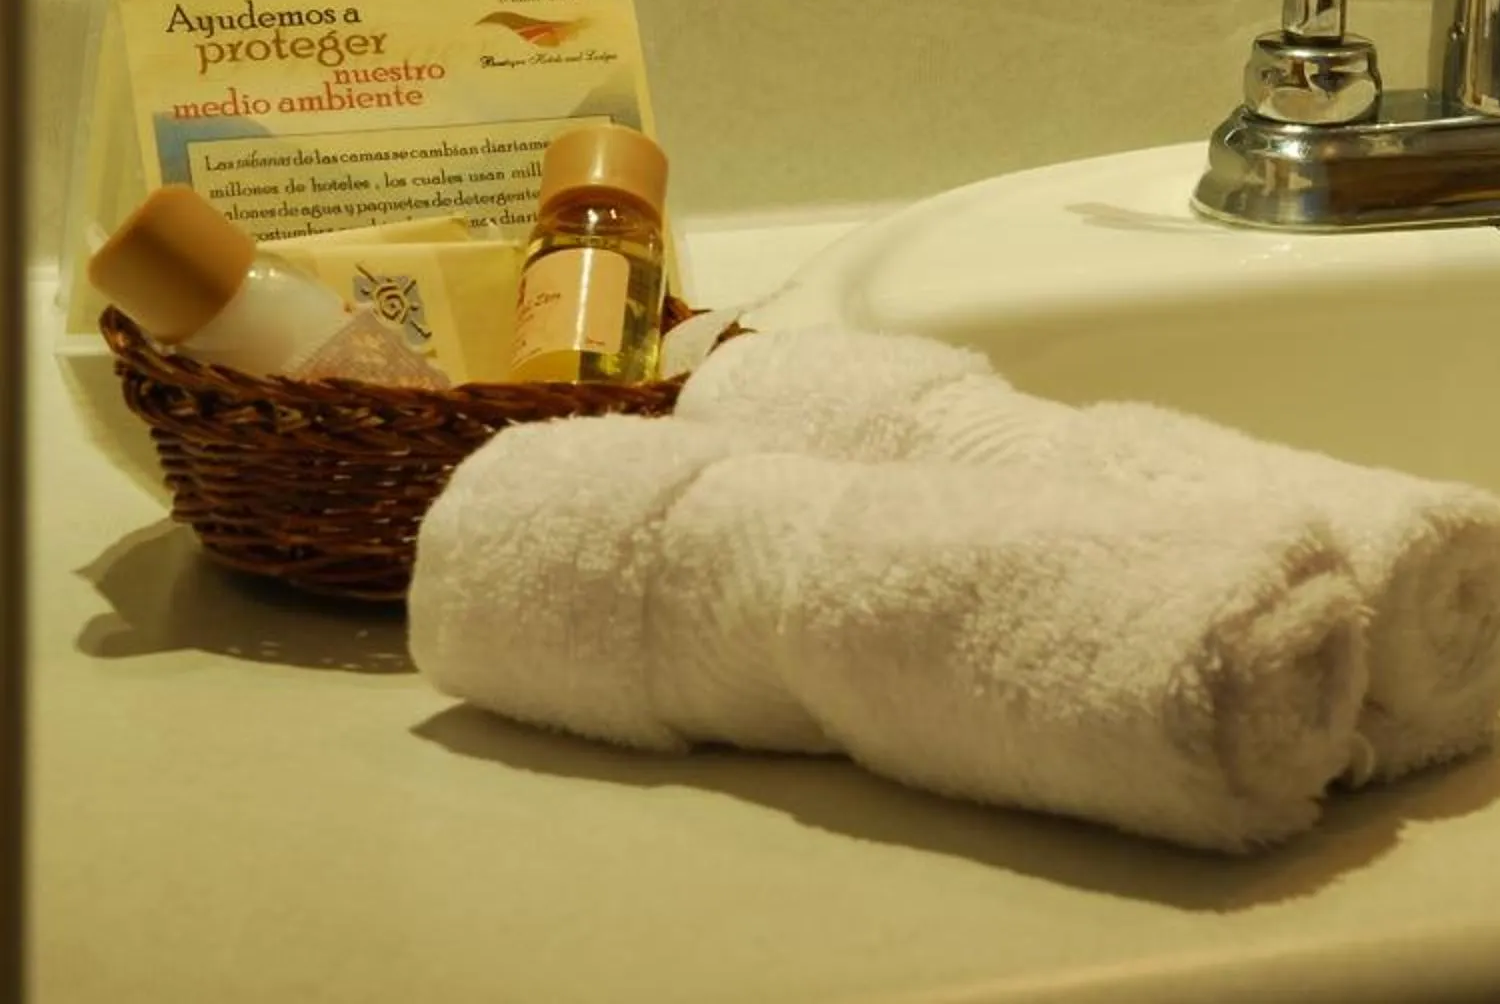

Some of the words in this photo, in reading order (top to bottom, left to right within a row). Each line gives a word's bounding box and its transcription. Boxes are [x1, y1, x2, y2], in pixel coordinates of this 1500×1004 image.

[343, 7, 362, 24] a
[195, 28, 388, 75] proteger
[333, 58, 446, 85] nuestro
[173, 86, 271, 121] medio
[278, 80, 424, 114] ambiente
[205, 155, 233, 171] Las
[235, 150, 290, 171] sábanas
[293, 149, 313, 166] de
[315, 149, 338, 164] las
[340, 150, 390, 163] camas
[392, 149, 408, 160] se
[409, 141, 479, 159] cambian
[210, 181, 279, 198] millones
[285, 177, 306, 194] de
[384, 172, 407, 188] los
[412, 169, 463, 187] cuales
[468, 171, 505, 183] usan
[224, 202, 276, 221] alones
[278, 201, 298, 217] de
[301, 204, 342, 219] agua
[344, 204, 354, 218] y
[356, 197, 430, 215] paquetes
[432, 191, 452, 207] de
